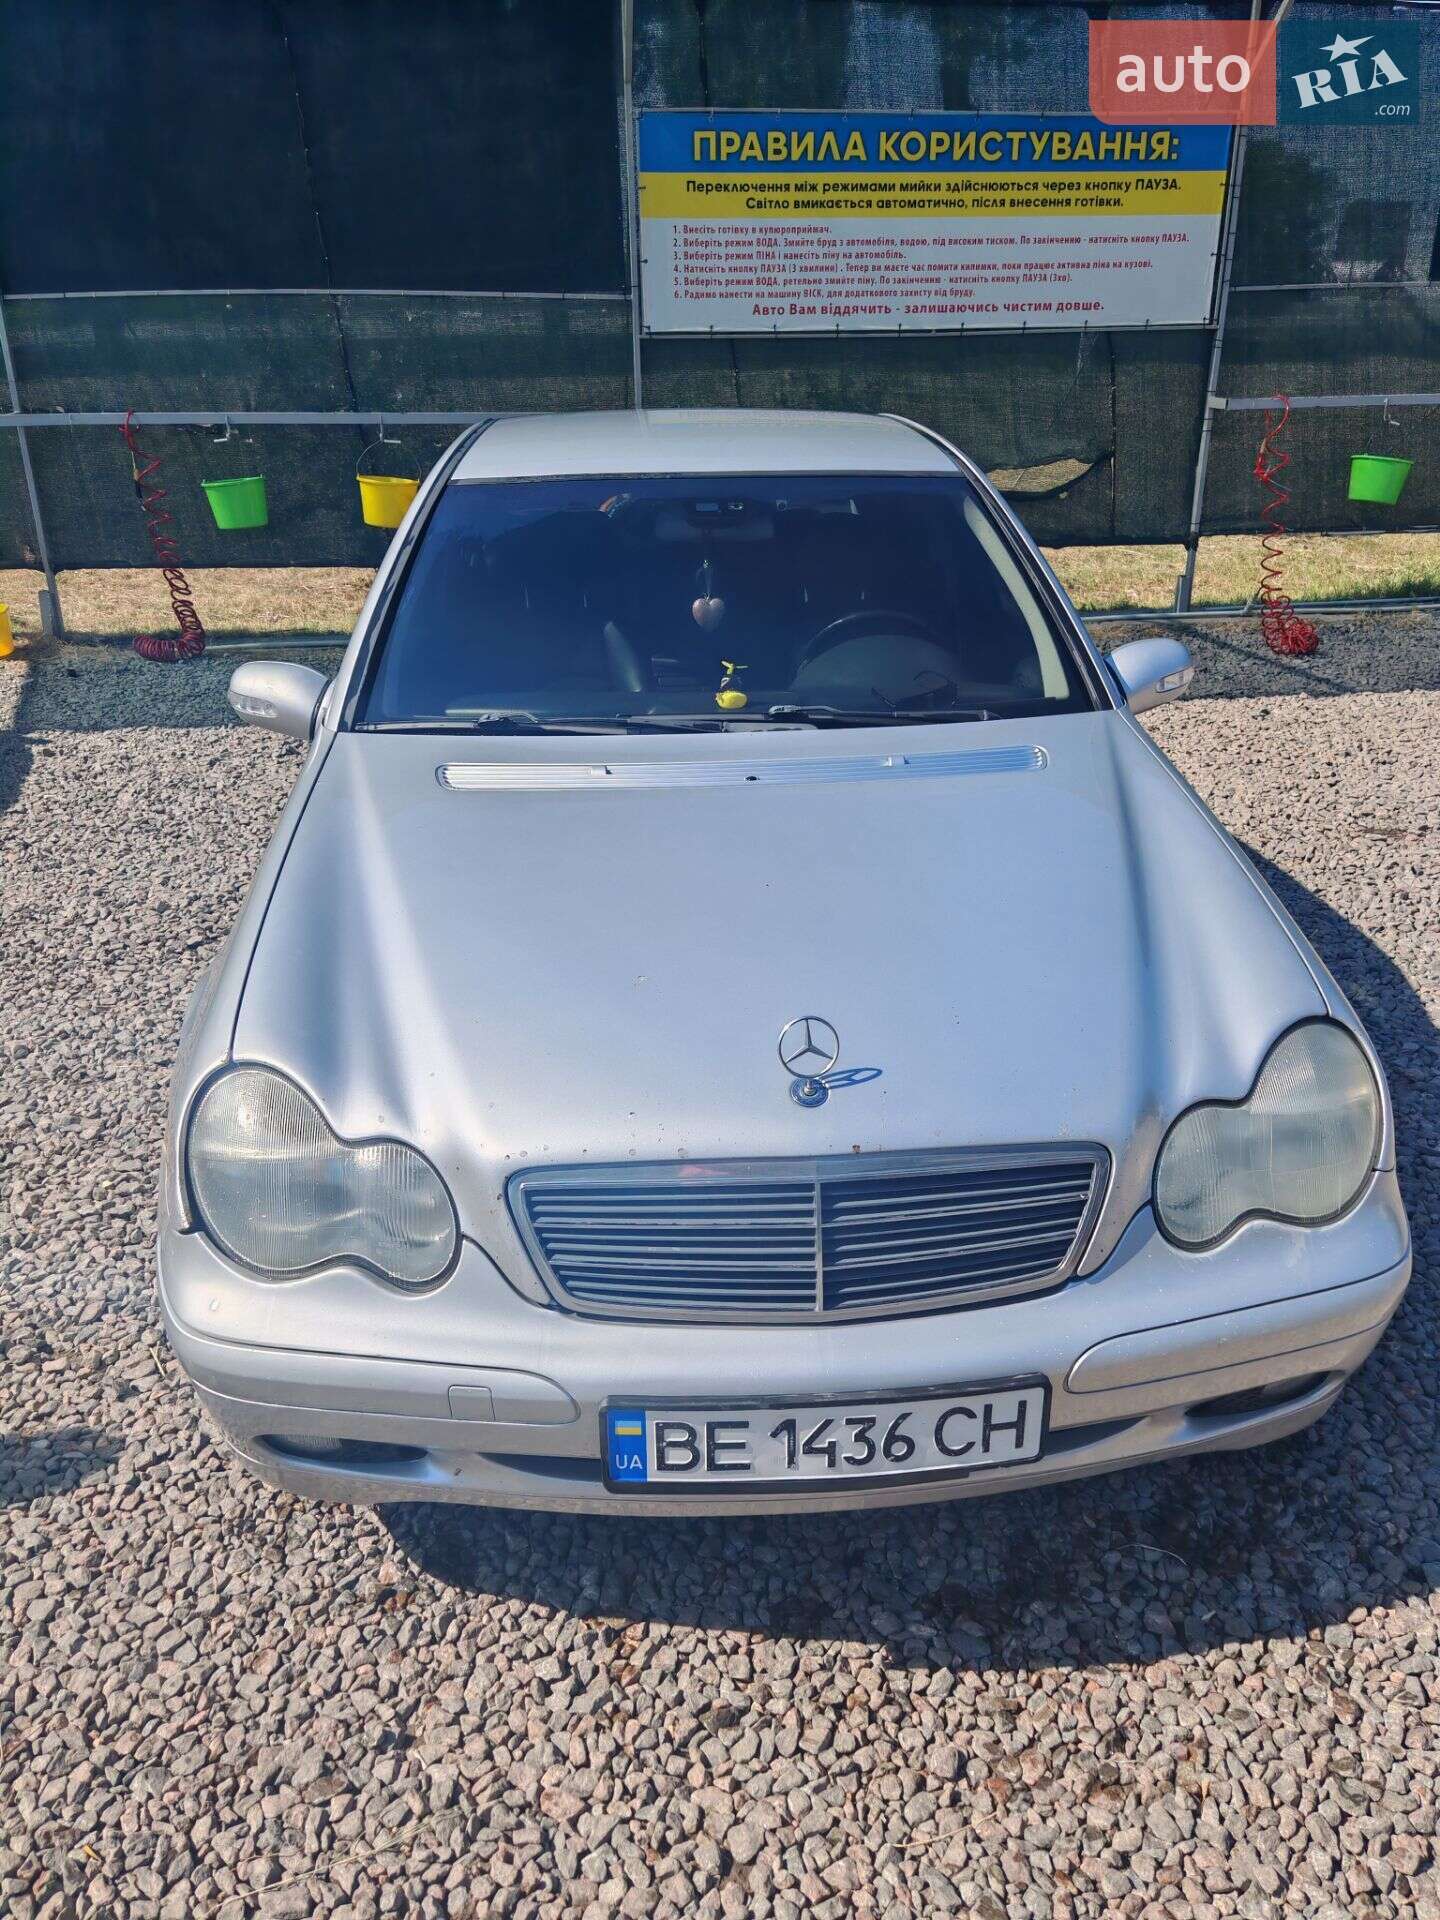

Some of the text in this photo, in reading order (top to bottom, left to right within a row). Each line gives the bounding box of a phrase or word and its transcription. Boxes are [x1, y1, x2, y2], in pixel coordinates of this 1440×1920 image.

[693, 130, 1179, 162] ПРАВИЛА КОРИСТУВАННЯ:
[686, 178, 1182, 194] Переключення між режимами мийки здійснюються через кнопку ПАУЗА.
[746, 195, 1124, 209] Світло вмикається автоматично, після внесення готівки.
[673, 225, 681, 234] 1.
[683, 225, 716, 234] Внесіть
[718, 225, 749, 236] готівку
[673, 238, 681, 247] 2.
[683, 237, 722, 249] Виберіть
[725, 239, 753, 249] режим
[817, 237, 837, 248] бруд
[933, 237, 946, 246] під
[1021, 236, 1031, 244] По
[1089, 235, 1129, 243] натисніть
[1131, 237, 1160, 246] кнопку
[1162, 234, 1190, 243] ПАУЗА.
[674, 251, 681, 260] 3.
[684, 251, 722, 262] Виберіть
[725, 253, 753, 262] режим
[756, 251, 776, 260] ПІНА
[784, 250, 820, 260] нанесіть
[823, 251, 840, 261] піну
[855, 249, 907, 259] автомобіль.
[673, 264, 681, 273] 4.
[684, 264, 726, 273] Натисніть
[728, 265, 758, 274] кнопку
[761, 264, 786, 272] ПАУЗА
[789, 264, 797, 273] (3
[846, 264, 869, 273] Тепер
[885, 263, 909, 271] маєте
[912, 263, 925, 271] час
[928, 263, 958, 271] помити
[1057, 261, 1090, 269] активна
[1093, 260, 1110, 269] піна
[1125, 259, 1153, 269] кузові.
[674, 277, 681, 286] 5.
[684, 277, 722, 288] Виберіть
[725, 278, 753, 288] режим
[784, 279, 822, 287] ретельно
[880, 275, 890, 284] По
[949, 274, 988, 283] натисніть
[991, 276, 1020, 284] кнопку
[1022, 273, 1047, 282] ПАУЗА
[674, 290, 682, 299] 6.
[684, 289, 717, 300] Радимо
[719, 290, 752, 298] нанести
[768, 290, 800, 299] машину
[844, 289, 898, 298] додаткового
[900, 290, 931, 298] захисту
[934, 288, 947, 296] від
[752, 303, 785, 316] Авто
[789, 303, 816, 315] Вам
[820, 303, 892, 317] віддячить
[904, 302, 999, 314] залишаючись
[1003, 302, 1052, 313] чистим
[1056, 301, 1104, 313] довше.
[654, 1400, 1028, 1472] BE 1436 CH
[615, 1455, 644, 1470] UA
